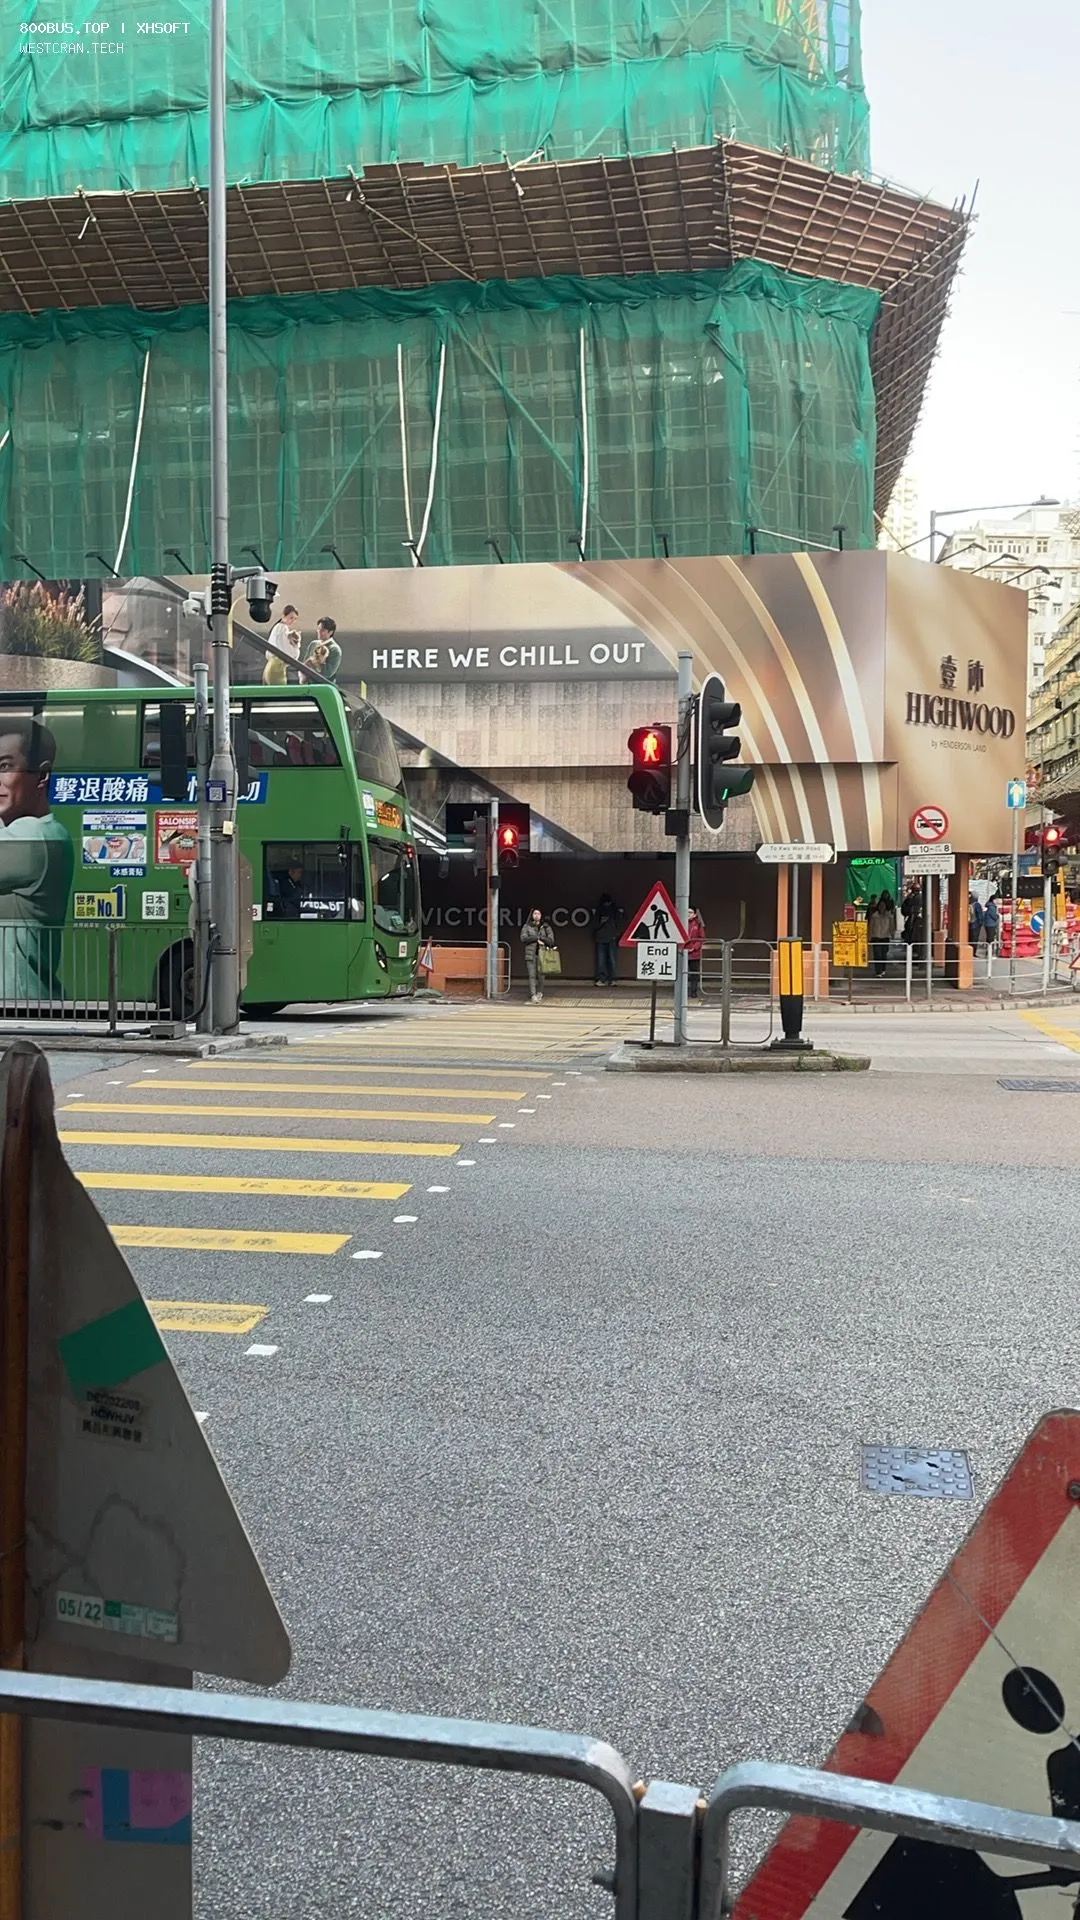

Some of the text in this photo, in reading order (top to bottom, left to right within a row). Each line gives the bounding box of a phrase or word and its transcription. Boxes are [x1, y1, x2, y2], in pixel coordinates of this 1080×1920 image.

[372, 643, 646, 669] HERE WE CHILL OUT
[904, 691, 1016, 740] HIGHWOOD
[940, 740, 972, 751] HENDERSON
[973, 744, 987, 753] LAND
[54, 776, 149, 802] 擊退酸痛
[158, 817, 197, 826] SALONSIP
[944, 844, 950, 852] 8
[76, 895, 96, 906] 世界
[145, 894, 166, 905] 日本
[76, 906, 96, 917] 品牌
[145, 906, 166, 917] 製造
[420, 907, 528, 927] VICTORI
[647, 946, 669, 956] End
[641, 961, 673, 976] 終止
[58, 1598, 102, 1621] 05/22
